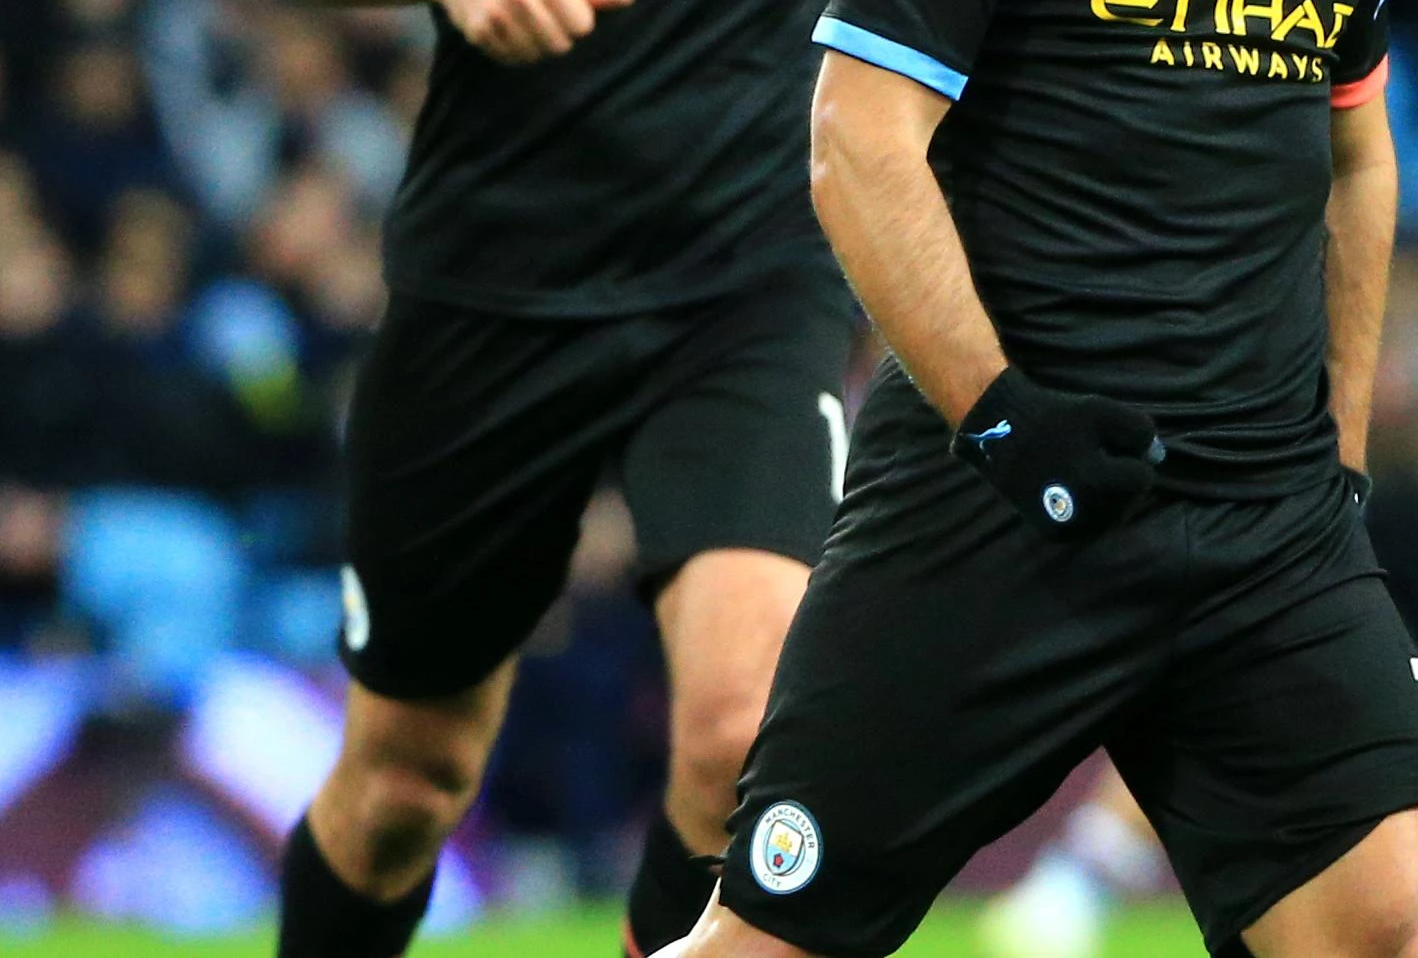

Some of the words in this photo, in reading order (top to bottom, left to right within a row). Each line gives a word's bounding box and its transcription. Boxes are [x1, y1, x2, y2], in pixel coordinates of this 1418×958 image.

[1151, 38, 1324, 82] AIRWAYS
[765, 807, 815, 849] MANCHESTER
[763, 874, 782, 888] CITY
